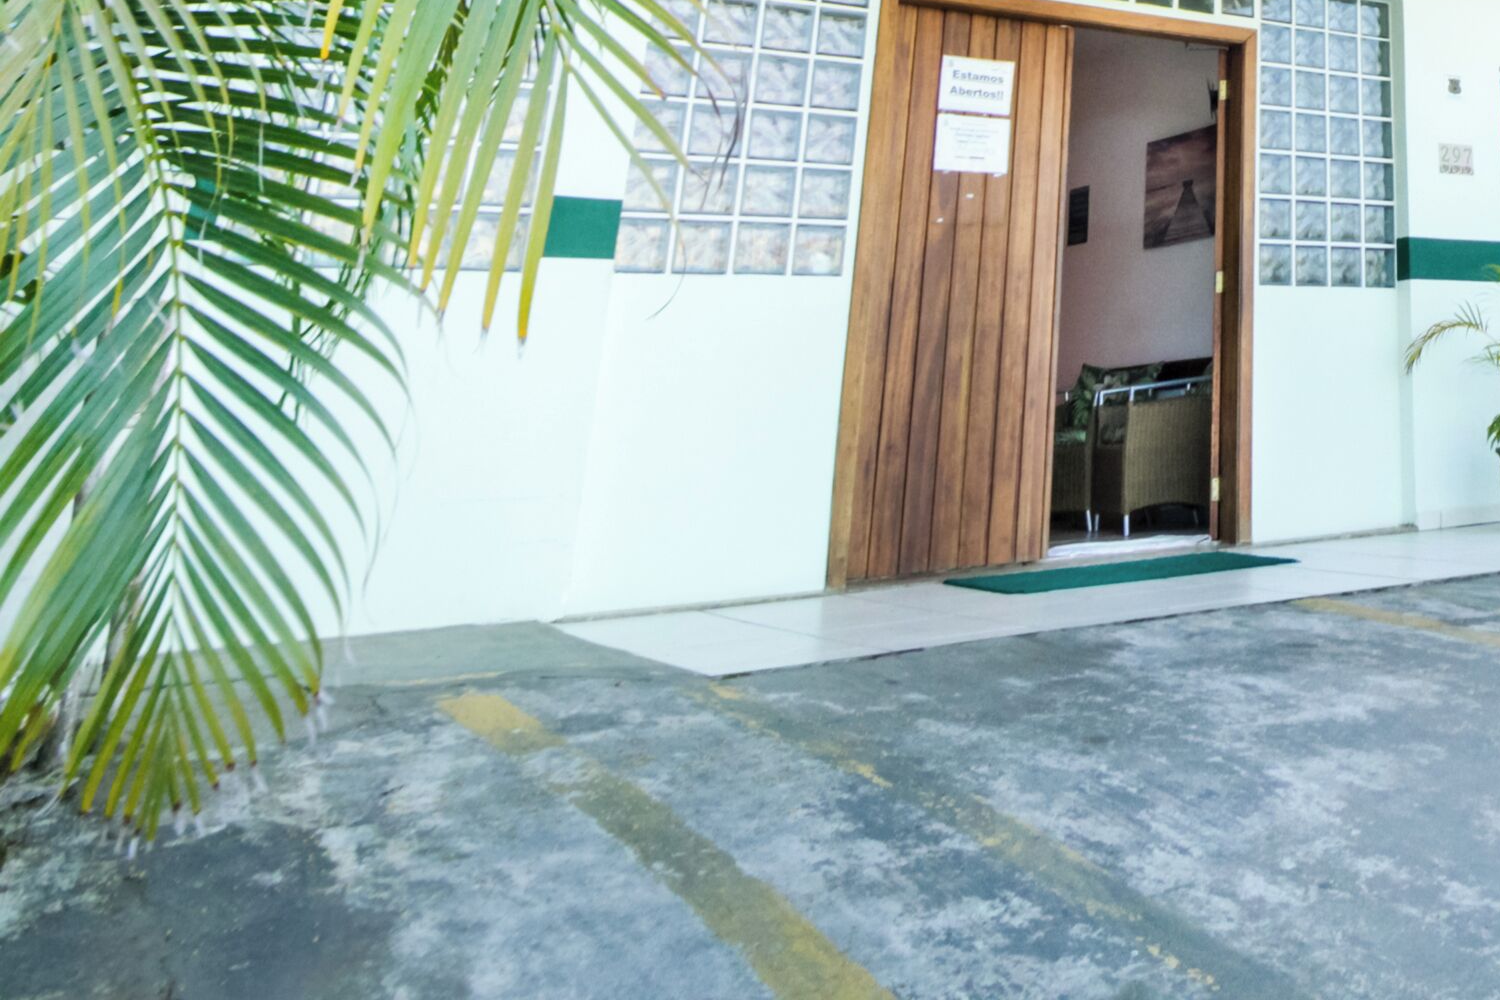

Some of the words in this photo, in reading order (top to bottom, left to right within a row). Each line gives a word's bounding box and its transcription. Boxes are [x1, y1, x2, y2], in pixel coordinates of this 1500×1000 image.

[952, 69, 1004, 84] Estamos
[950, 86, 1004, 100] Abertos!!
[1440, 145, 1472, 164] 297
